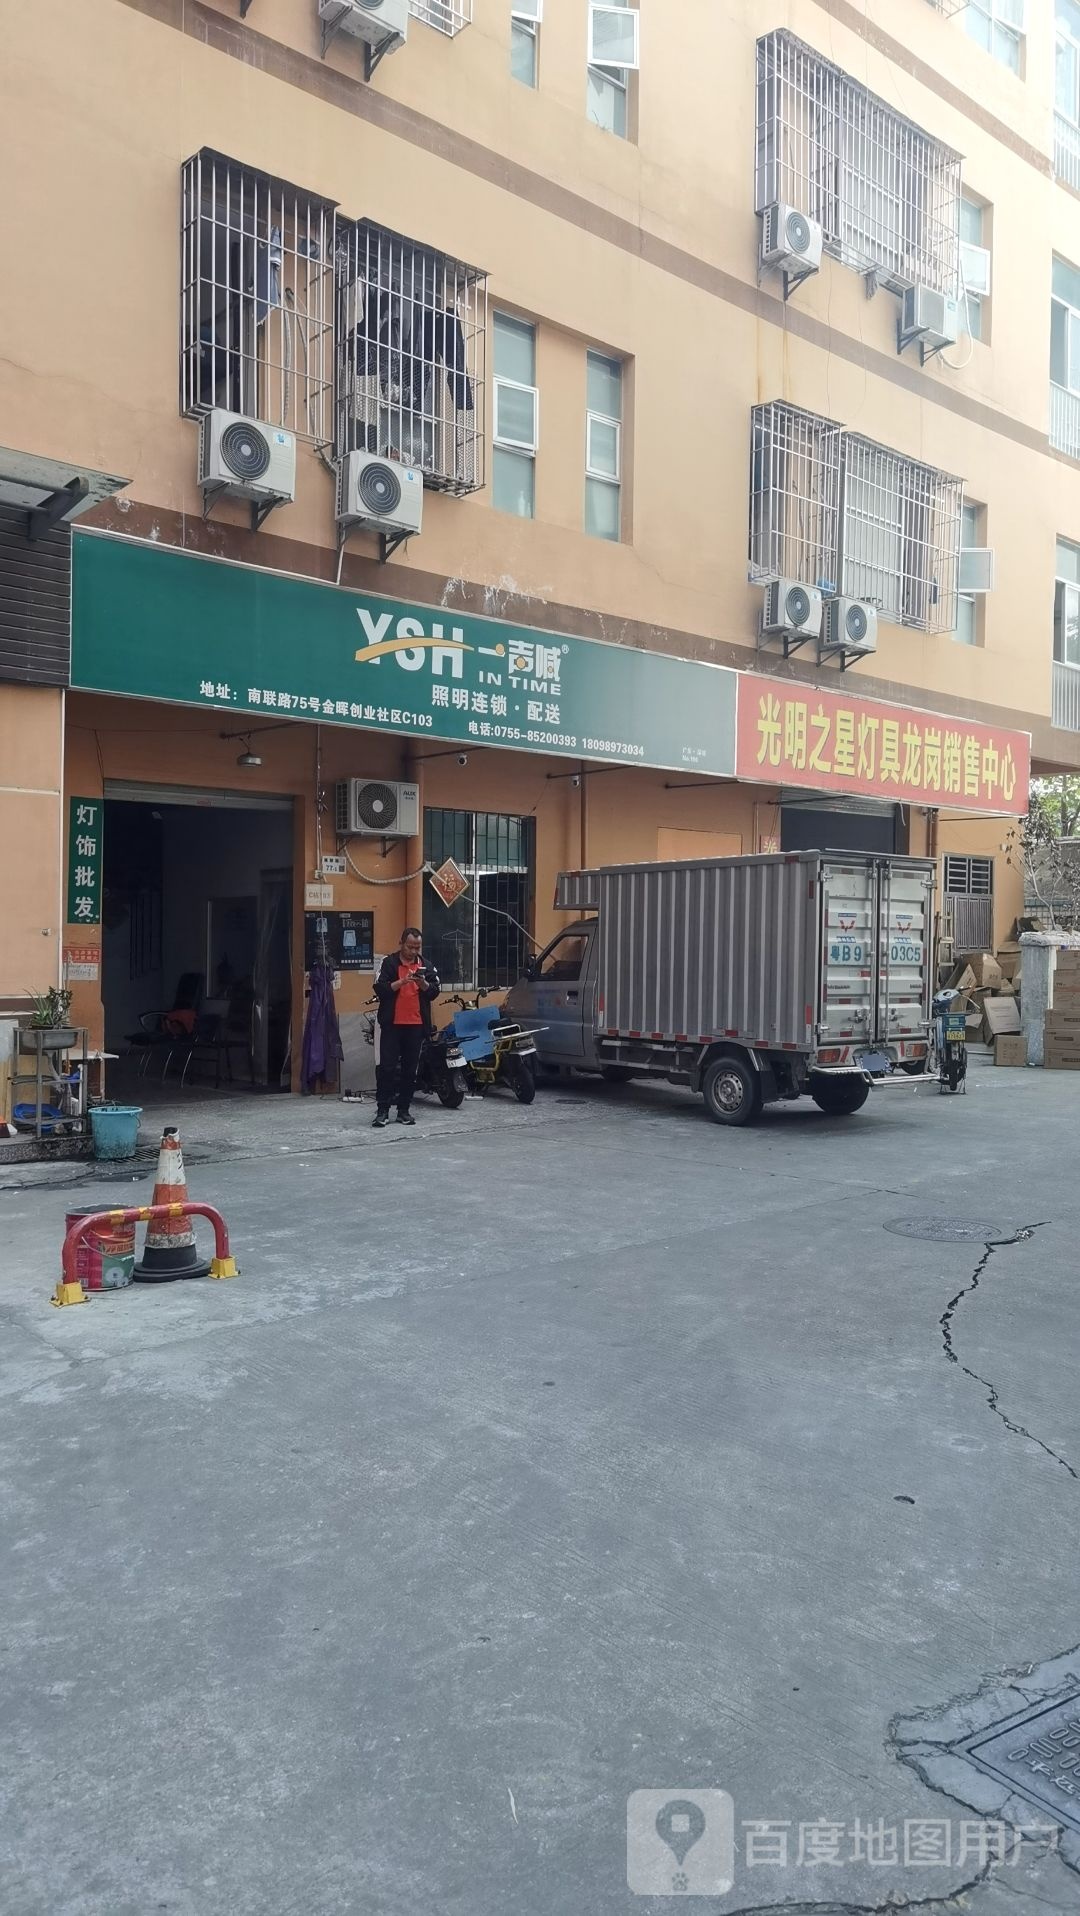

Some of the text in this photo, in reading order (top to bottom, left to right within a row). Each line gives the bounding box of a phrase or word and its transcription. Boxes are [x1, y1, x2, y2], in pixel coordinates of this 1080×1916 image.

[356, 608, 464, 679] YSH
[479, 671, 561, 696] IN TIME
[582, 738, 645, 756] 18098973034
[757, 693, 1017, 801] 光明之星灯具龙岗销售中心
[73, 804, 98, 918] 灯饰批发
